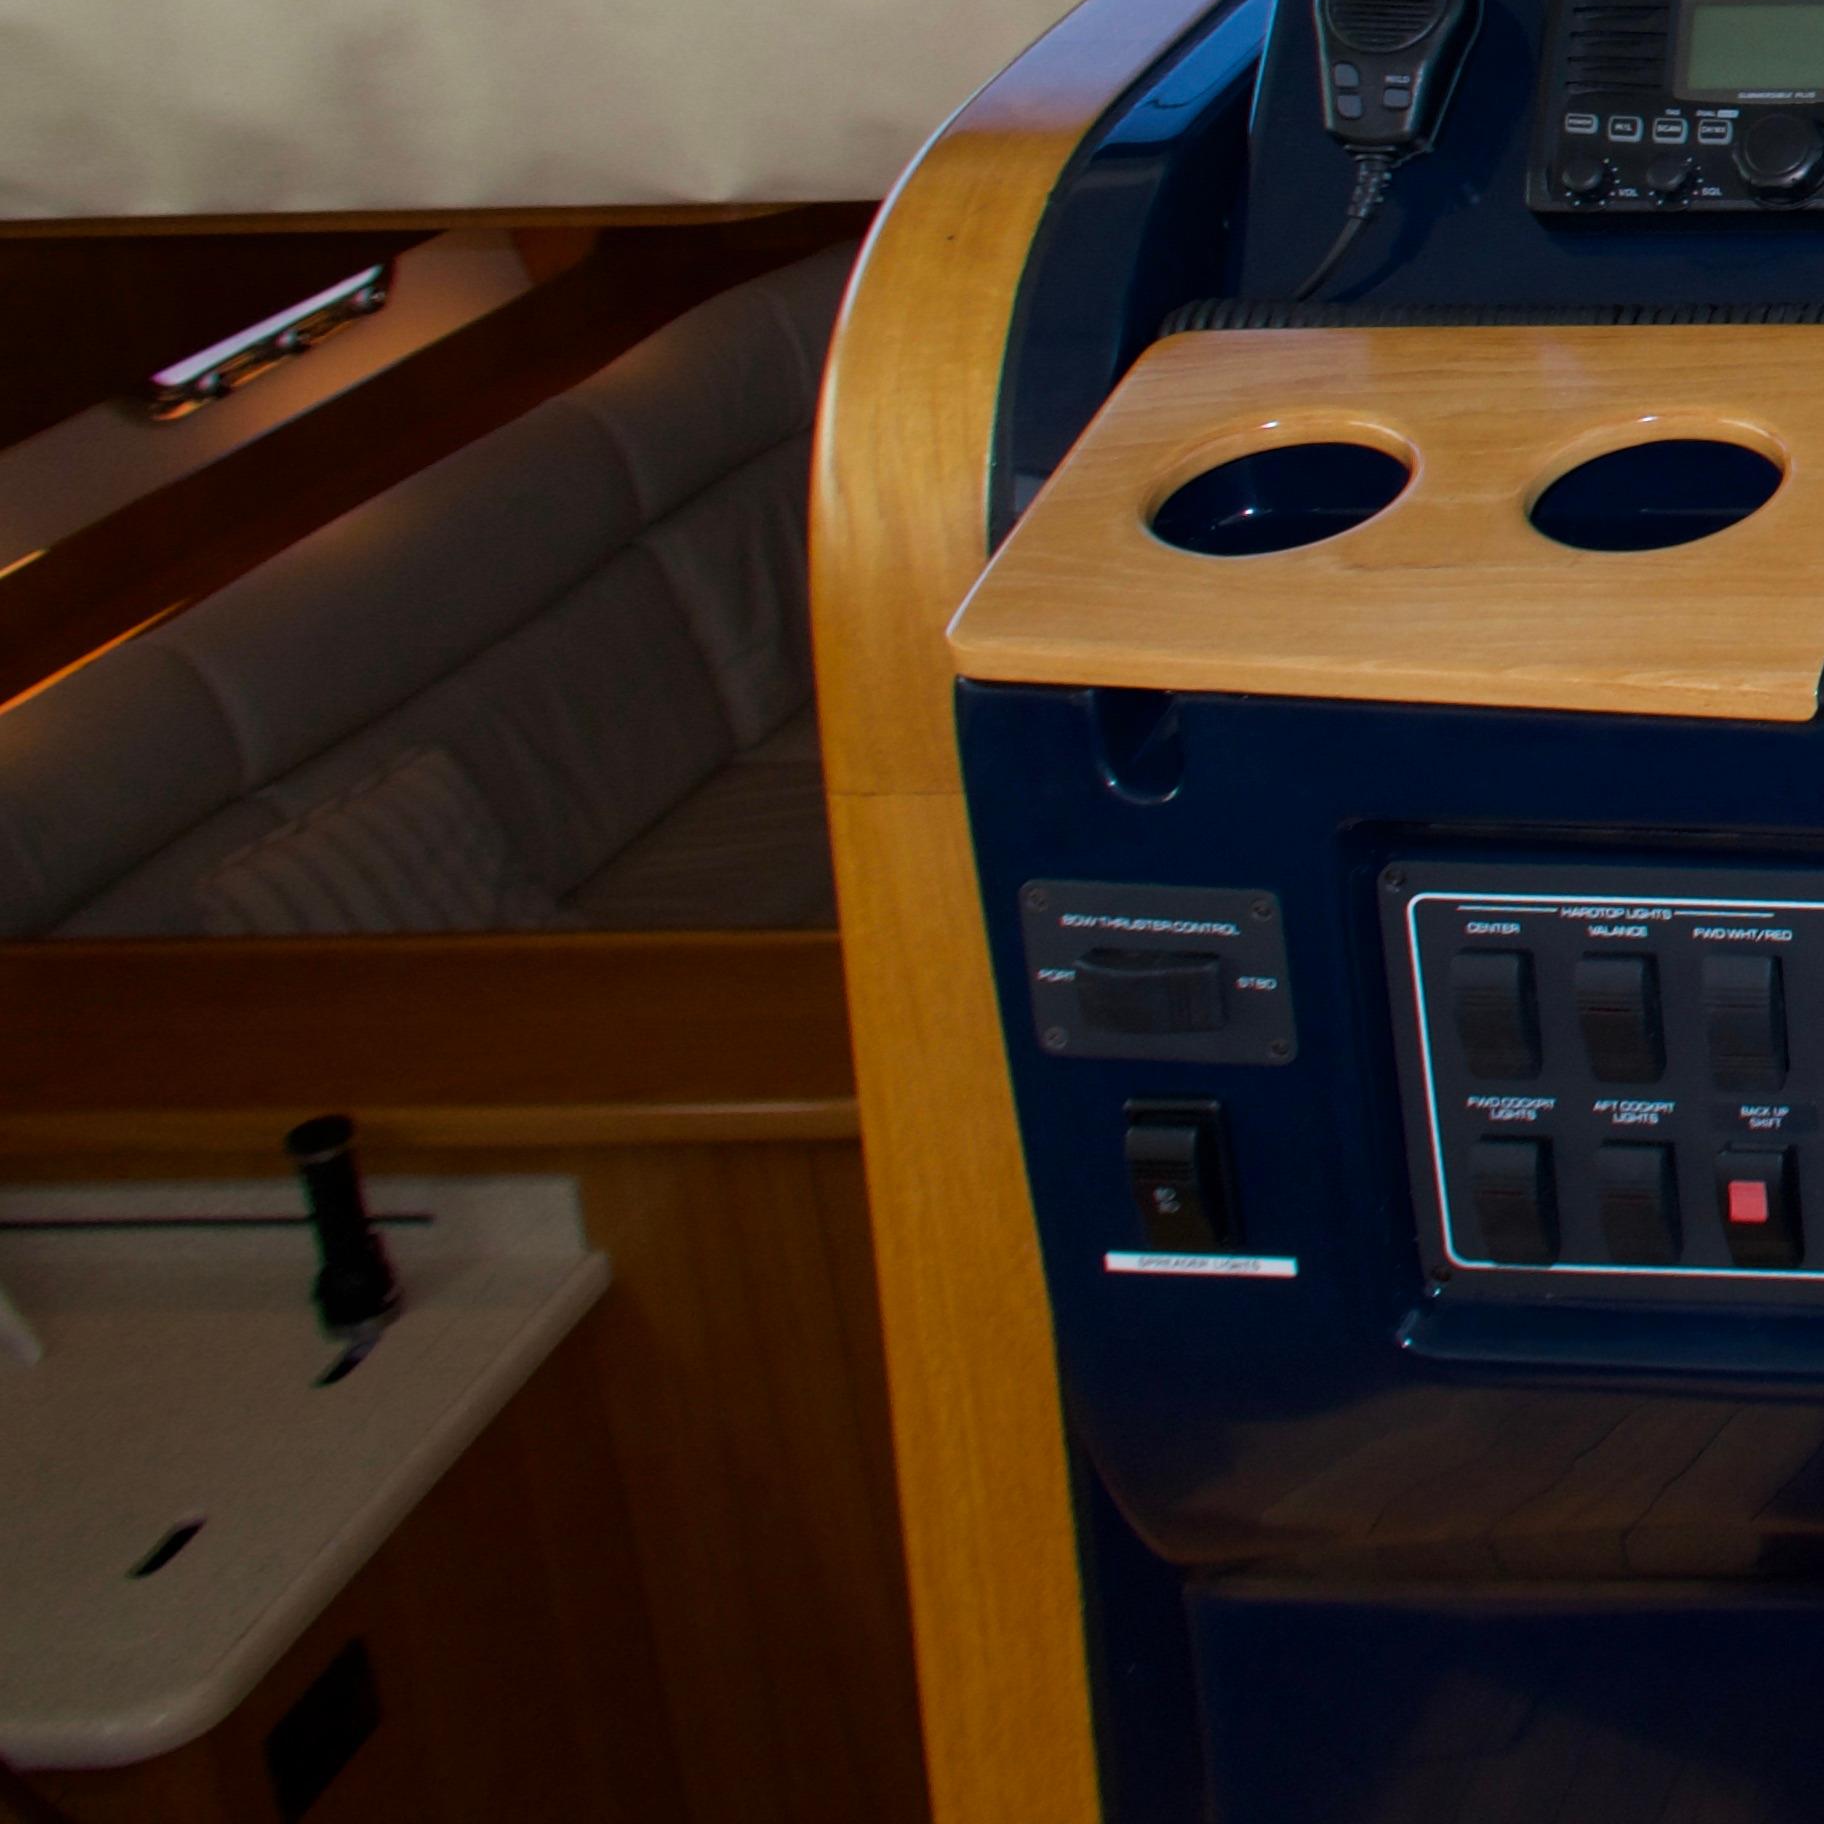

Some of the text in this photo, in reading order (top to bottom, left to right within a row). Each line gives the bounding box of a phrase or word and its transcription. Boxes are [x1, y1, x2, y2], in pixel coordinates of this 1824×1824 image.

[1561, 906, 1672, 921] HARDTOP LIGHTS
[1062, 913, 1240, 937] BOW THRUSTER CONTROL
[1465, 920, 1520, 935] CENTER
[1588, 924, 1648, 938] VALANCE
[1692, 926, 1793, 942] FWD WHT/RED
[1467, 1095, 1557, 1112] FWD COCKPIT
[1593, 1099, 1676, 1115] AFT COCKPIT
[1489, 1108, 1537, 1121] LIGHTS
[1612, 1112, 1660, 1125] LIGHTS
